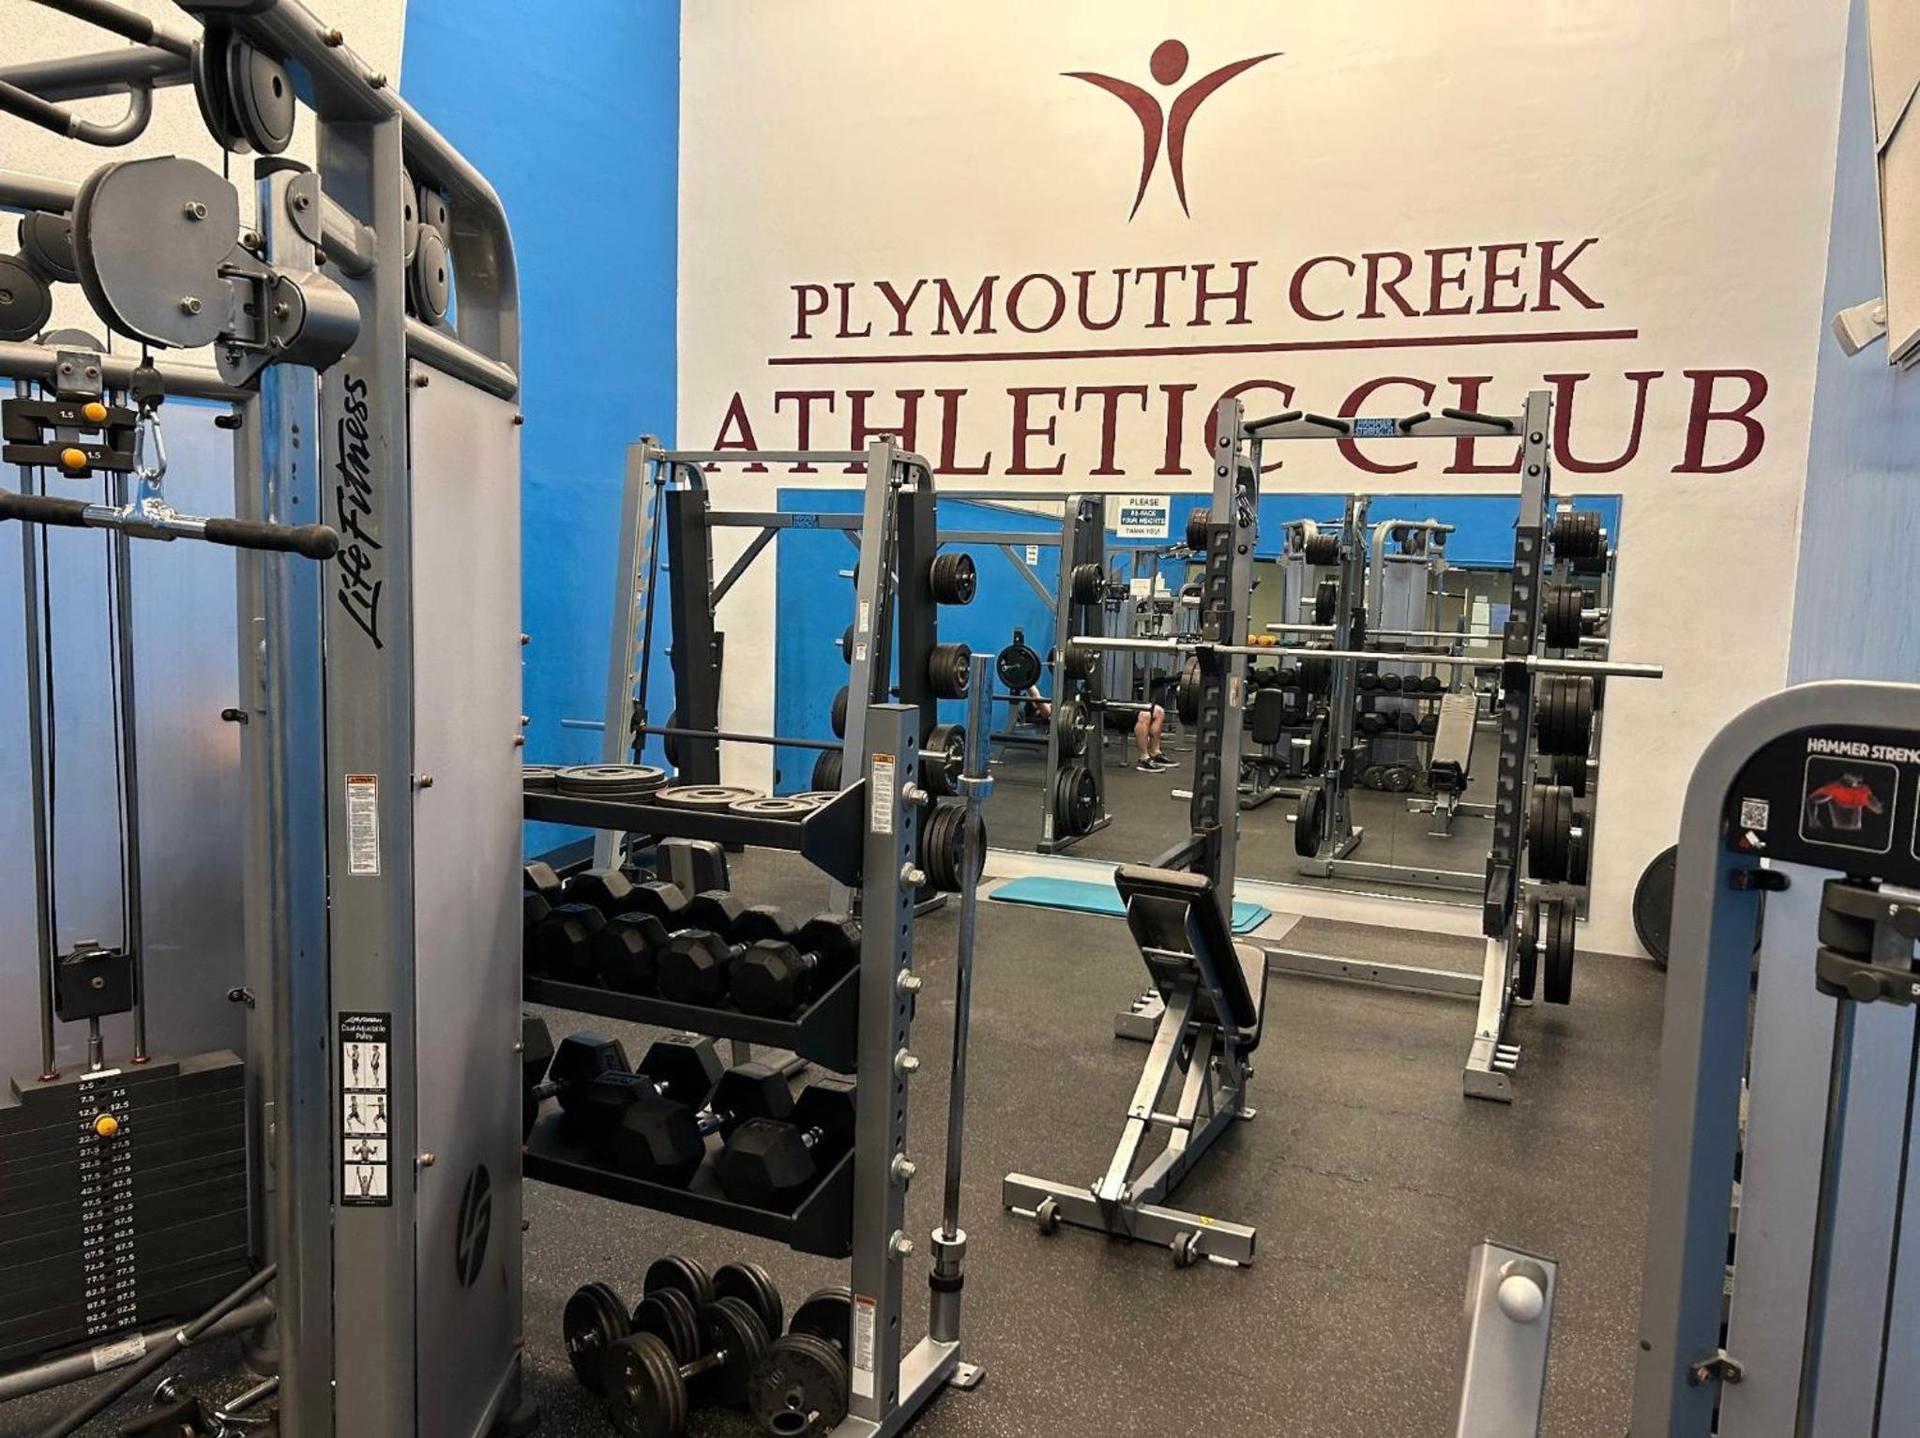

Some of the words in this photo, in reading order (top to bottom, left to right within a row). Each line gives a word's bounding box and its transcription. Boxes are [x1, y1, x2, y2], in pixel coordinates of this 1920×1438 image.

[790, 260, 1258, 340] PLYMOUTH
[1288, 237, 1605, 321] CREEK
[60, 410, 74, 418] 1.5
[702, 379, 1296, 476] ATHLETIC
[1335, 368, 1769, 475] CLUB
[1130, 498, 1159, 506] PLEASE
[1807, 738, 1870, 757] HAMMER
[110, 1101, 129, 1111] 12.5
